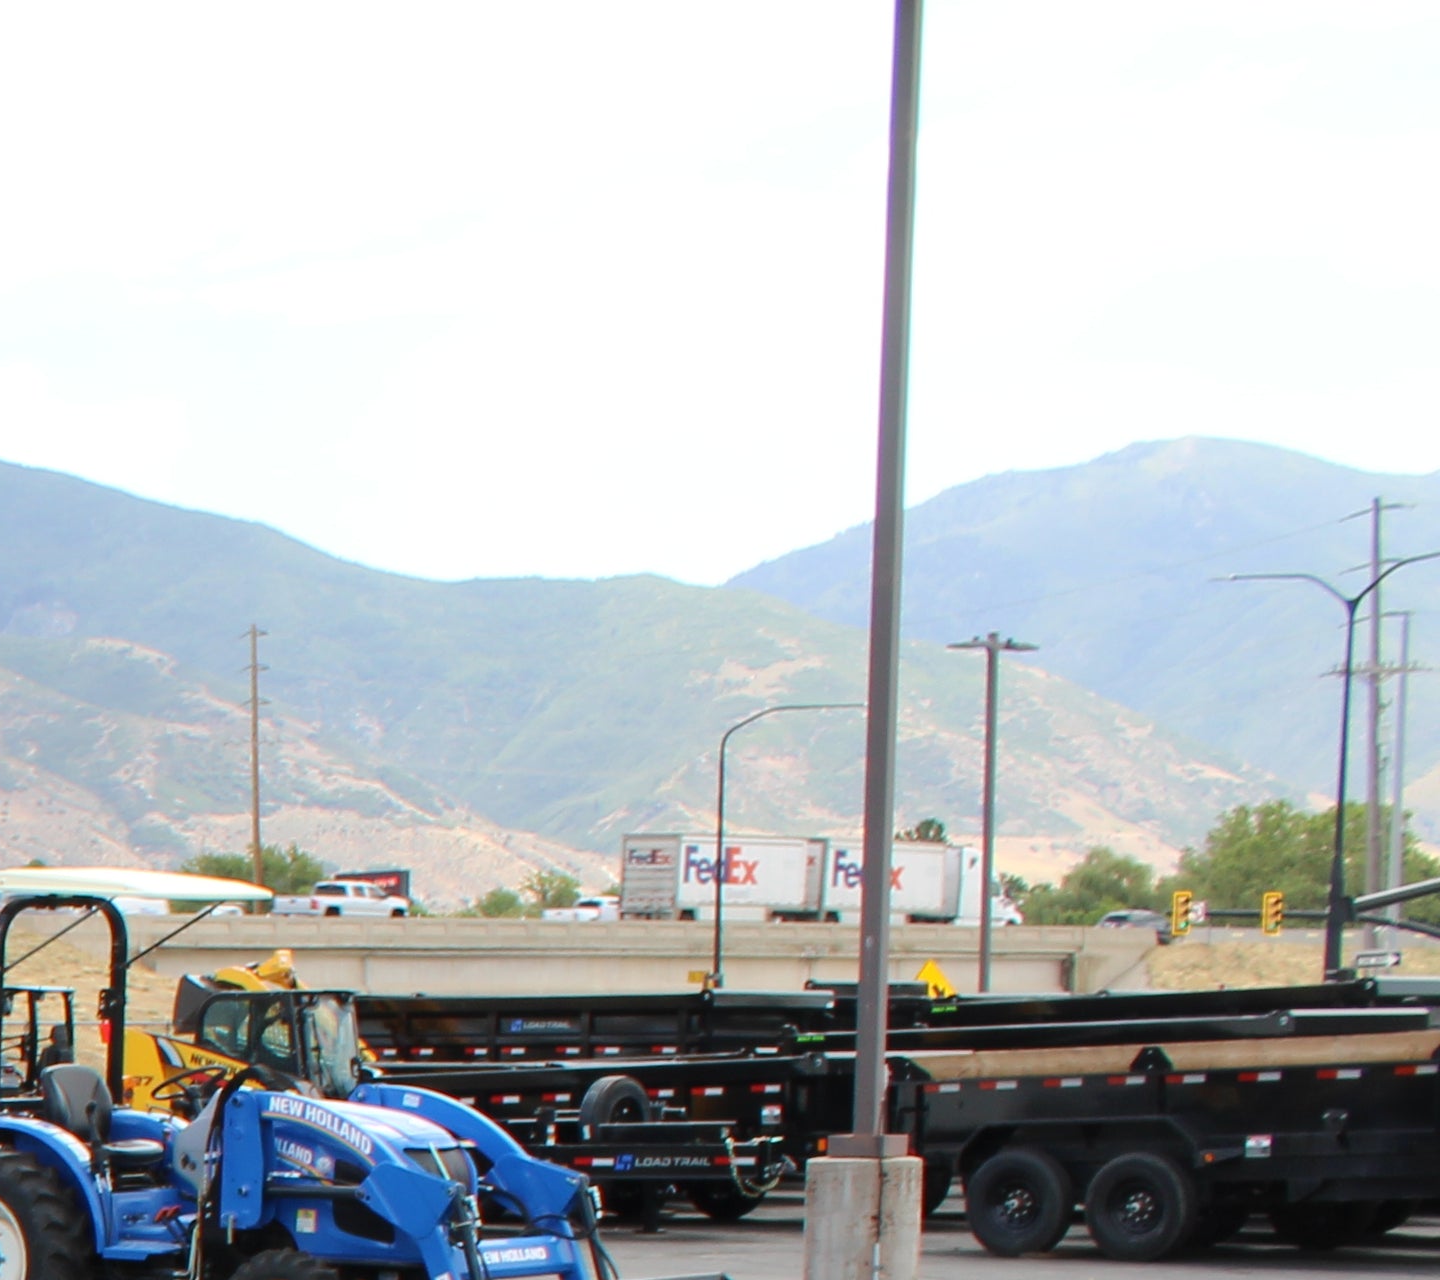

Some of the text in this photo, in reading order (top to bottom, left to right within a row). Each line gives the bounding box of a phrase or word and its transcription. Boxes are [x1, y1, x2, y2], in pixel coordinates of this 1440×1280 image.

[629, 849, 671, 865] FedEx
[683, 845, 759, 885] FedEx
[832, 850, 905, 890] Fex
[268, 1096, 373, 1156] NEW HOLLAND
[274, 1136, 313, 1165] LLAND
[634, 1156, 711, 1168] LOAD TRAIL
